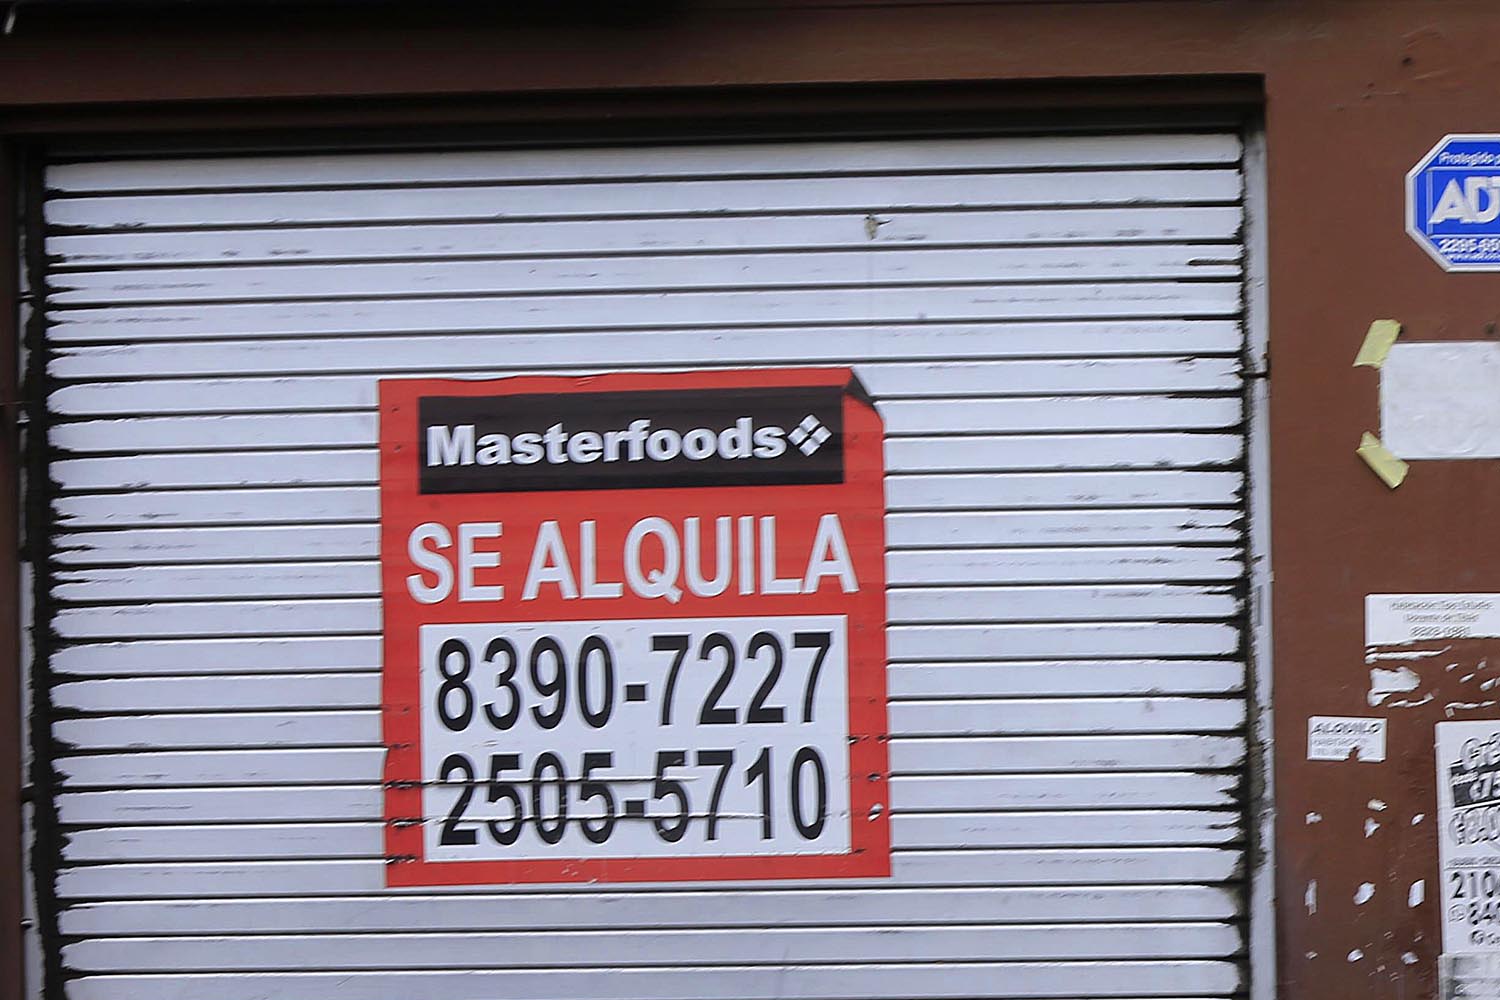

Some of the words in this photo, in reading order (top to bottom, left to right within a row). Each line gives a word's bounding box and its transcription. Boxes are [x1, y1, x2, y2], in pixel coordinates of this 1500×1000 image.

[426, 417, 787, 467] Masterfoods
[406, 521, 504, 604] SE
[521, 513, 860, 604] ALQUILA
[438, 631, 832, 731] 8390-7227
[1310, 722, 1382, 735] ALQUILO
[437, 746, 828, 846] 2505-5710
